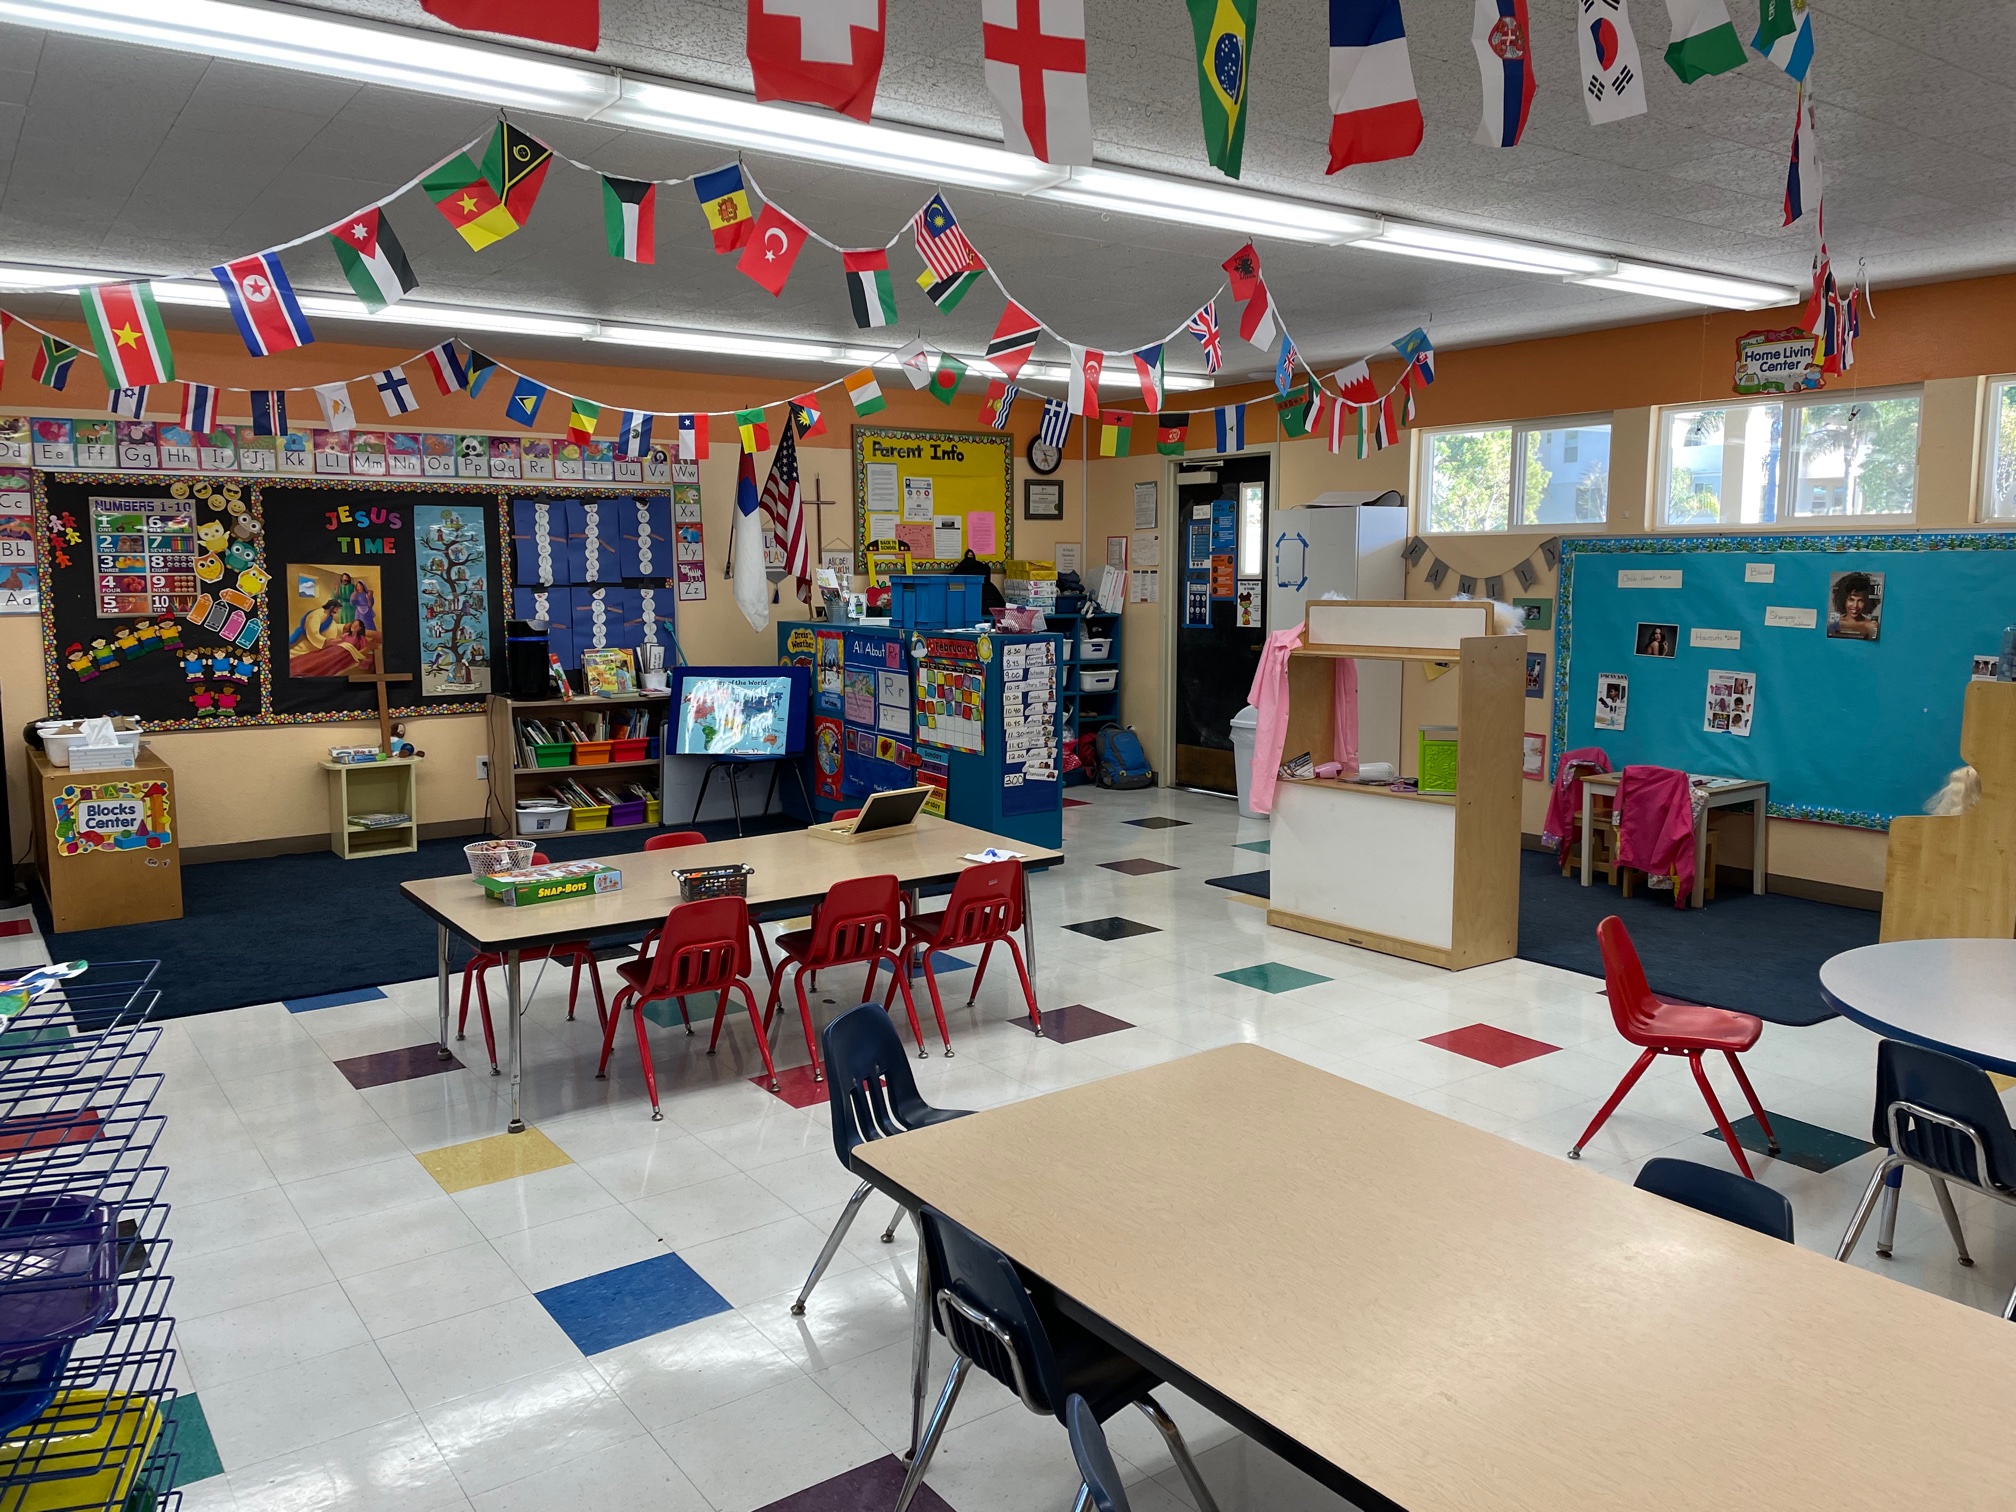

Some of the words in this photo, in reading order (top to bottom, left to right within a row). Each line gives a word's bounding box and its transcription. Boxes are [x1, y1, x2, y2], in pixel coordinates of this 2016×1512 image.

[1744, 350, 1780, 362] Home
[1760, 360, 1801, 372] Center
[872, 440, 923, 458] Parent
[930, 444, 964, 462] Info
[95, 500, 154, 512] NUMBERS
[160, 502, 190, 512] 1-10
[98, 516, 110, 527] 1
[149, 516, 162, 528] 6
[325, 506, 402, 530] JESUS
[100, 536, 113, 548] 2
[149, 536, 162, 548] 7
[337, 537, 396, 554] TIME
[100, 556, 114, 568] 3
[150, 556, 164, 568] 8
[102, 576, 116, 588] 4
[152, 576, 166, 588] 9
[104, 596, 116, 608] 5
[153, 596, 168, 607] 10
[865, 643, 885, 657] About
[936, 642, 969, 655] February
[925, 750, 942, 762] Sunday
[924, 762, 942, 772] Monday
[87, 803, 136, 816] Blocks
[86, 817, 136, 829] Center
